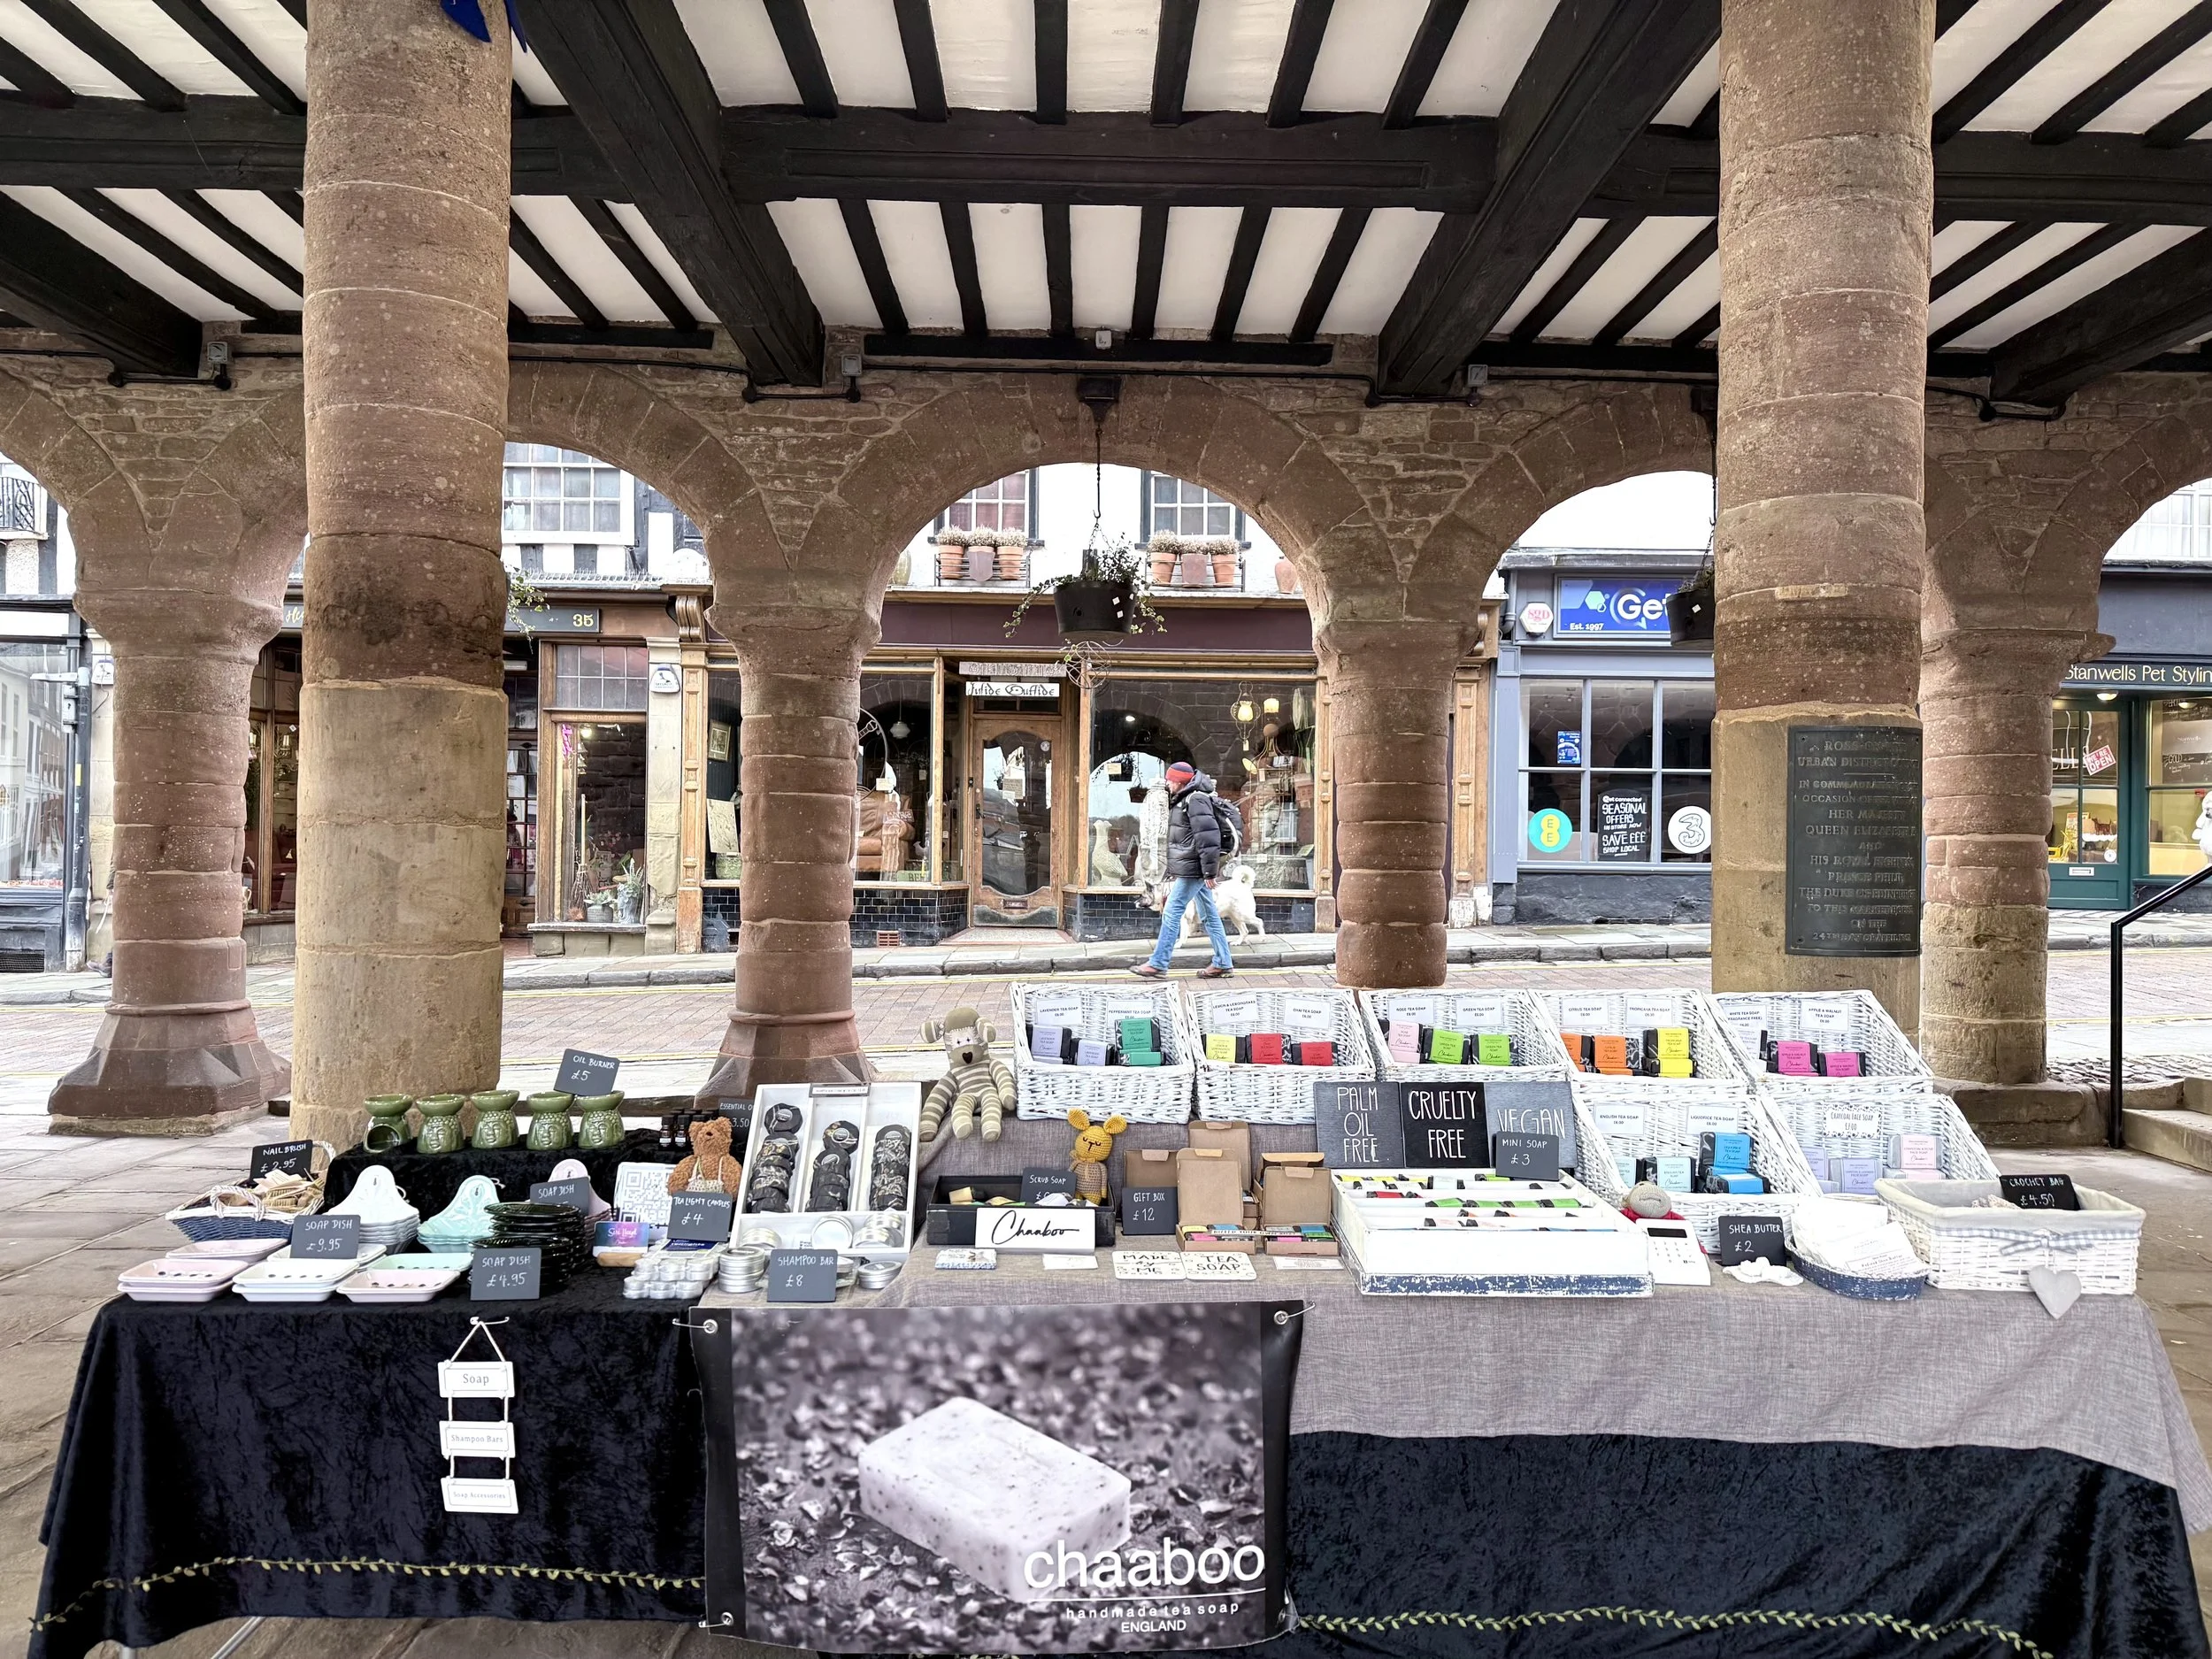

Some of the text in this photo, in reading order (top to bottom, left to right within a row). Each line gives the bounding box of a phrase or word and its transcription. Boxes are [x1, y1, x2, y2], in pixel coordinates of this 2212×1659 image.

[572, 614, 594, 627] 35
[2142, 665, 2166, 681] Pet
[1797, 757, 1837, 766] URBAN
[2087, 747, 2108, 763] WE'RE
[2089, 753, 2115, 772] OPEN
[1802, 795, 1855, 803] OCCASION
[1601, 803, 1647, 815] SEASONAL
[1828, 809, 1855, 818] HER
[1606, 814, 1634, 824] OFFERS
[1805, 825, 1849, 836] QUEEN
[1601, 833, 1628, 847] SAVE
[1809, 855, 1829, 865] HIS
[1798, 887, 1821, 896] THE
[588, 1058, 616, 1069] BURNER
[571, 1070, 591, 1080] £5
[1337, 1087, 1378, 1110] PALM
[1409, 1090, 1477, 1120] CRUELTY
[1344, 1112, 1374, 1137] OIL
[1497, 1108, 1566, 1139] VEGAN
[263, 1143, 307, 1156] NAIL BRUSH
[1343, 1137, 1379, 1163] FREE
[1427, 1129, 1466, 1159] FREE
[1502, 1139, 1548, 1148] MINI SOAP
[1510, 1153, 1531, 1165] £3
[1029, 1175, 1067, 1185] SCRUB SOAP
[2009, 1177, 2046, 1187] CROCHET
[538, 1184, 574, 1199] SOAP DISH
[1133, 1192, 1165, 1202] GIFT BOX
[673, 1196, 731, 1209] TEA LIGHT CANDLES
[305, 1219, 353, 1231] SOAP DISH
[681, 1213, 704, 1225] £4
[991, 1210, 1080, 1245] Chaaboo
[1729, 1224, 1783, 1234] SHEA BUTTER
[306, 1238, 343, 1252] £9.95
[1734, 1240, 1755, 1253] £2
[482, 1255, 531, 1268] SOAP DISH
[778, 1256, 834, 1266] SHAMPOO BAR
[487, 1271, 527, 1287] £4.95
[786, 1274, 804, 1287] £8
[463, 1373, 489, 1386] Soap
[451, 1434, 485, 1443] Shampoo
[1024, 1537, 1265, 1588] chaaboo
[1066, 1601, 1240, 1619] handmade tea soap
[1121, 1619, 1187, 1633] ENGLAND
